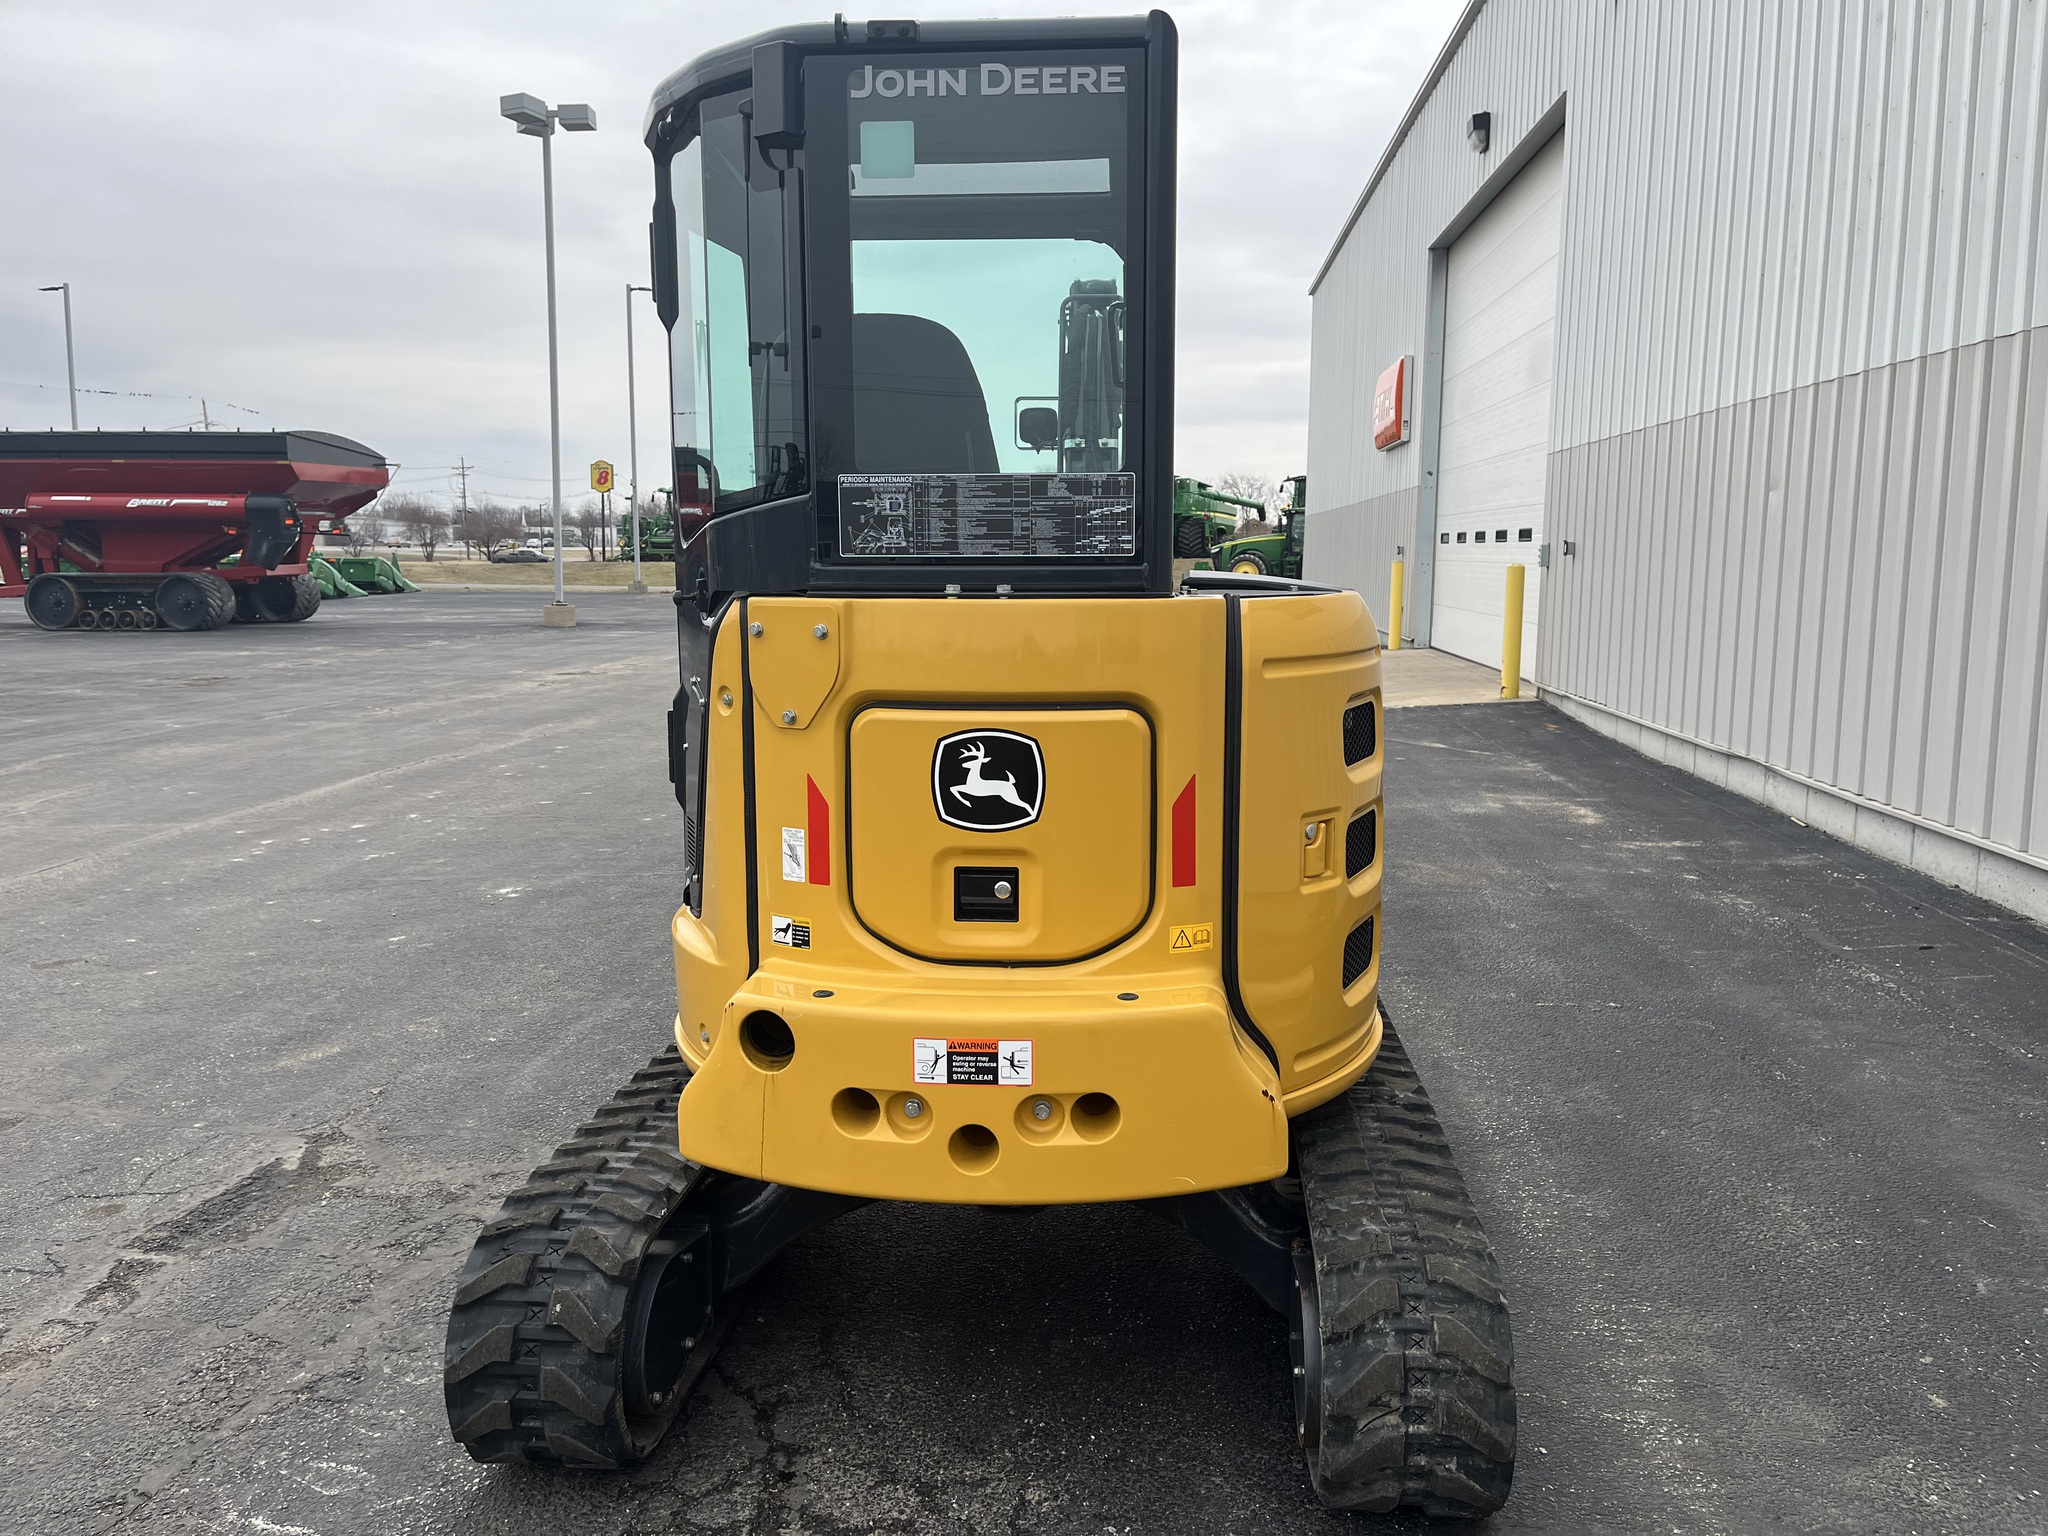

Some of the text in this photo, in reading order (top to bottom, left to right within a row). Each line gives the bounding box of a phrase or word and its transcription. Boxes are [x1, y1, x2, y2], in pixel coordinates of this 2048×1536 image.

[851, 63, 1126, 98] JOHN DEERE
[596, 470, 609, 486] 8
[957, 1042, 997, 1050] WARNING
